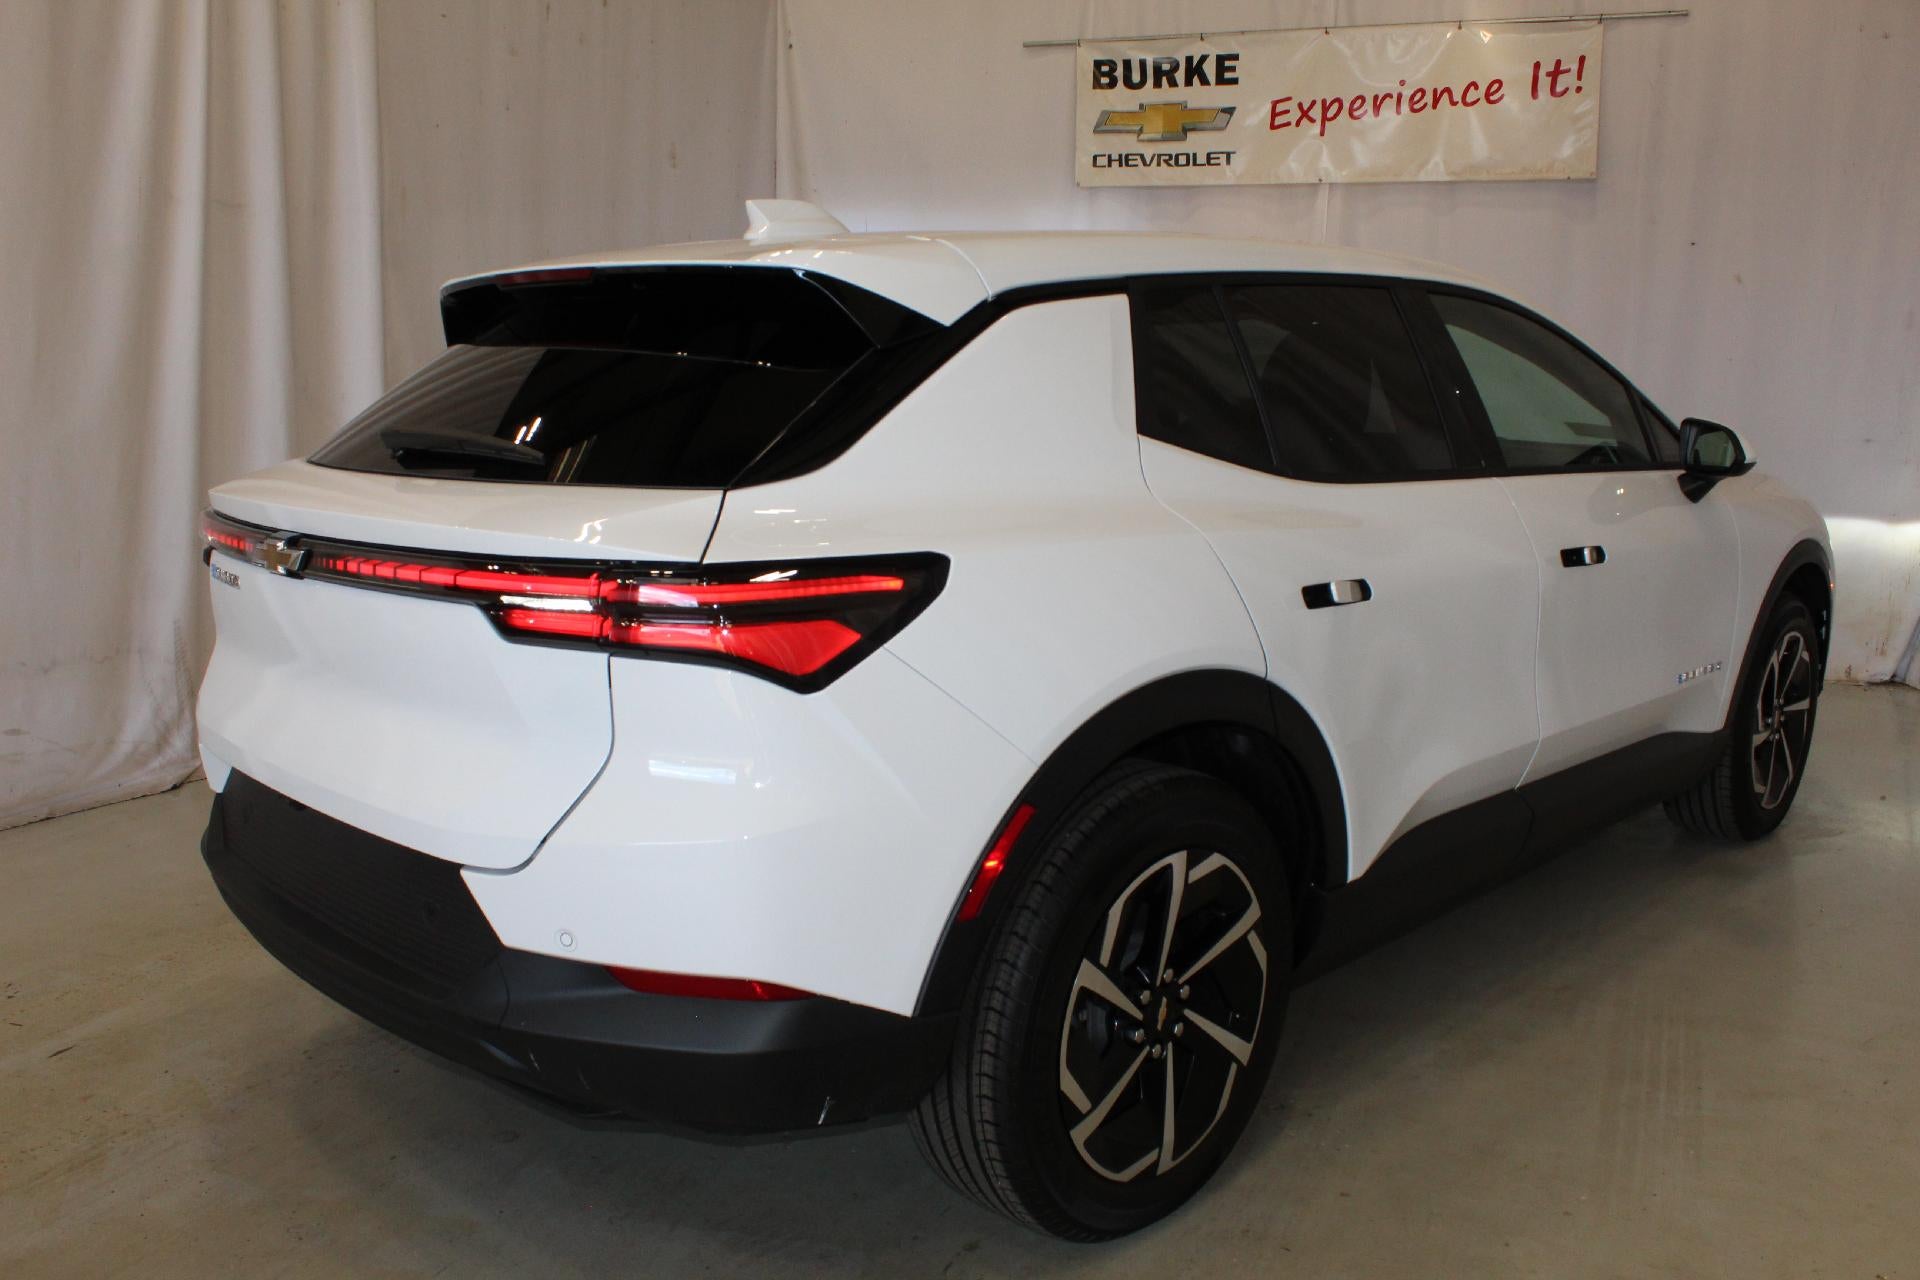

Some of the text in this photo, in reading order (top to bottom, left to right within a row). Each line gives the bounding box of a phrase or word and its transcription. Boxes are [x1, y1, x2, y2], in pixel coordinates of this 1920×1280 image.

[1092, 53, 1240, 90] BURKE
[1269, 55, 1586, 136] Experience It!
[1092, 150, 1236, 168] CHEVROLET
